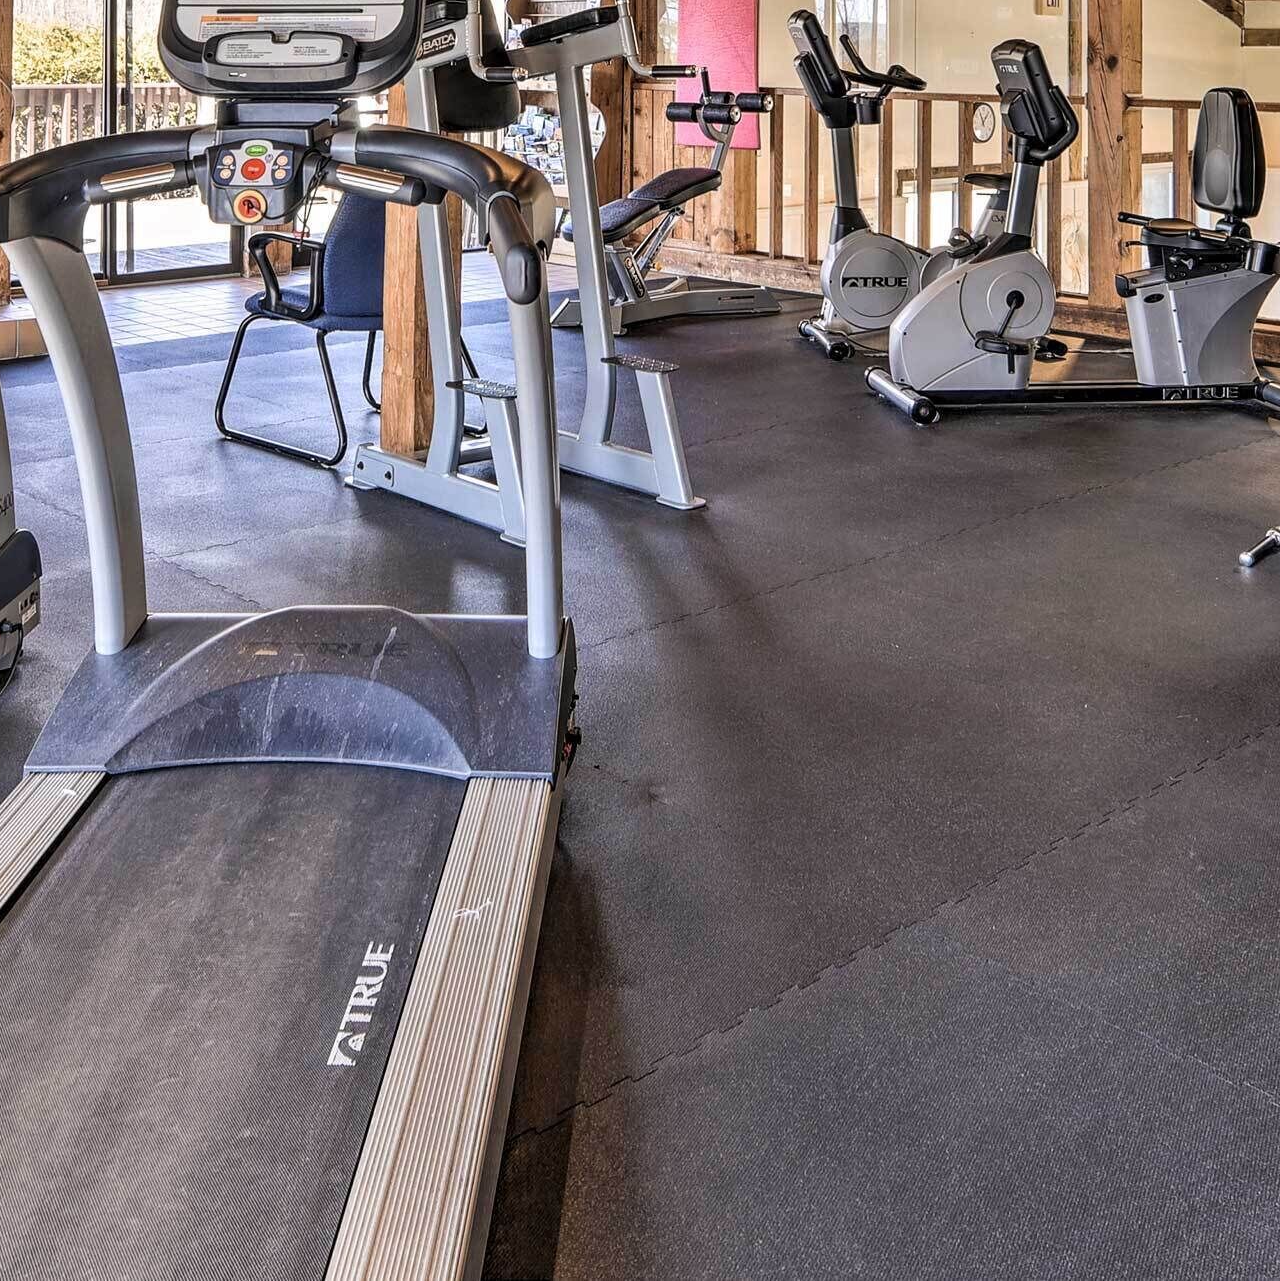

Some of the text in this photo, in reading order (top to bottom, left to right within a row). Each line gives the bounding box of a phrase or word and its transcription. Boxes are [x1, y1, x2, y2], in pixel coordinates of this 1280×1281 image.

[423, 33, 455, 51] BATCA
[859, 276, 908, 288] TRUE
[1184, 386, 1239, 399] TRUE
[339, 940, 395, 1031] TRUE
